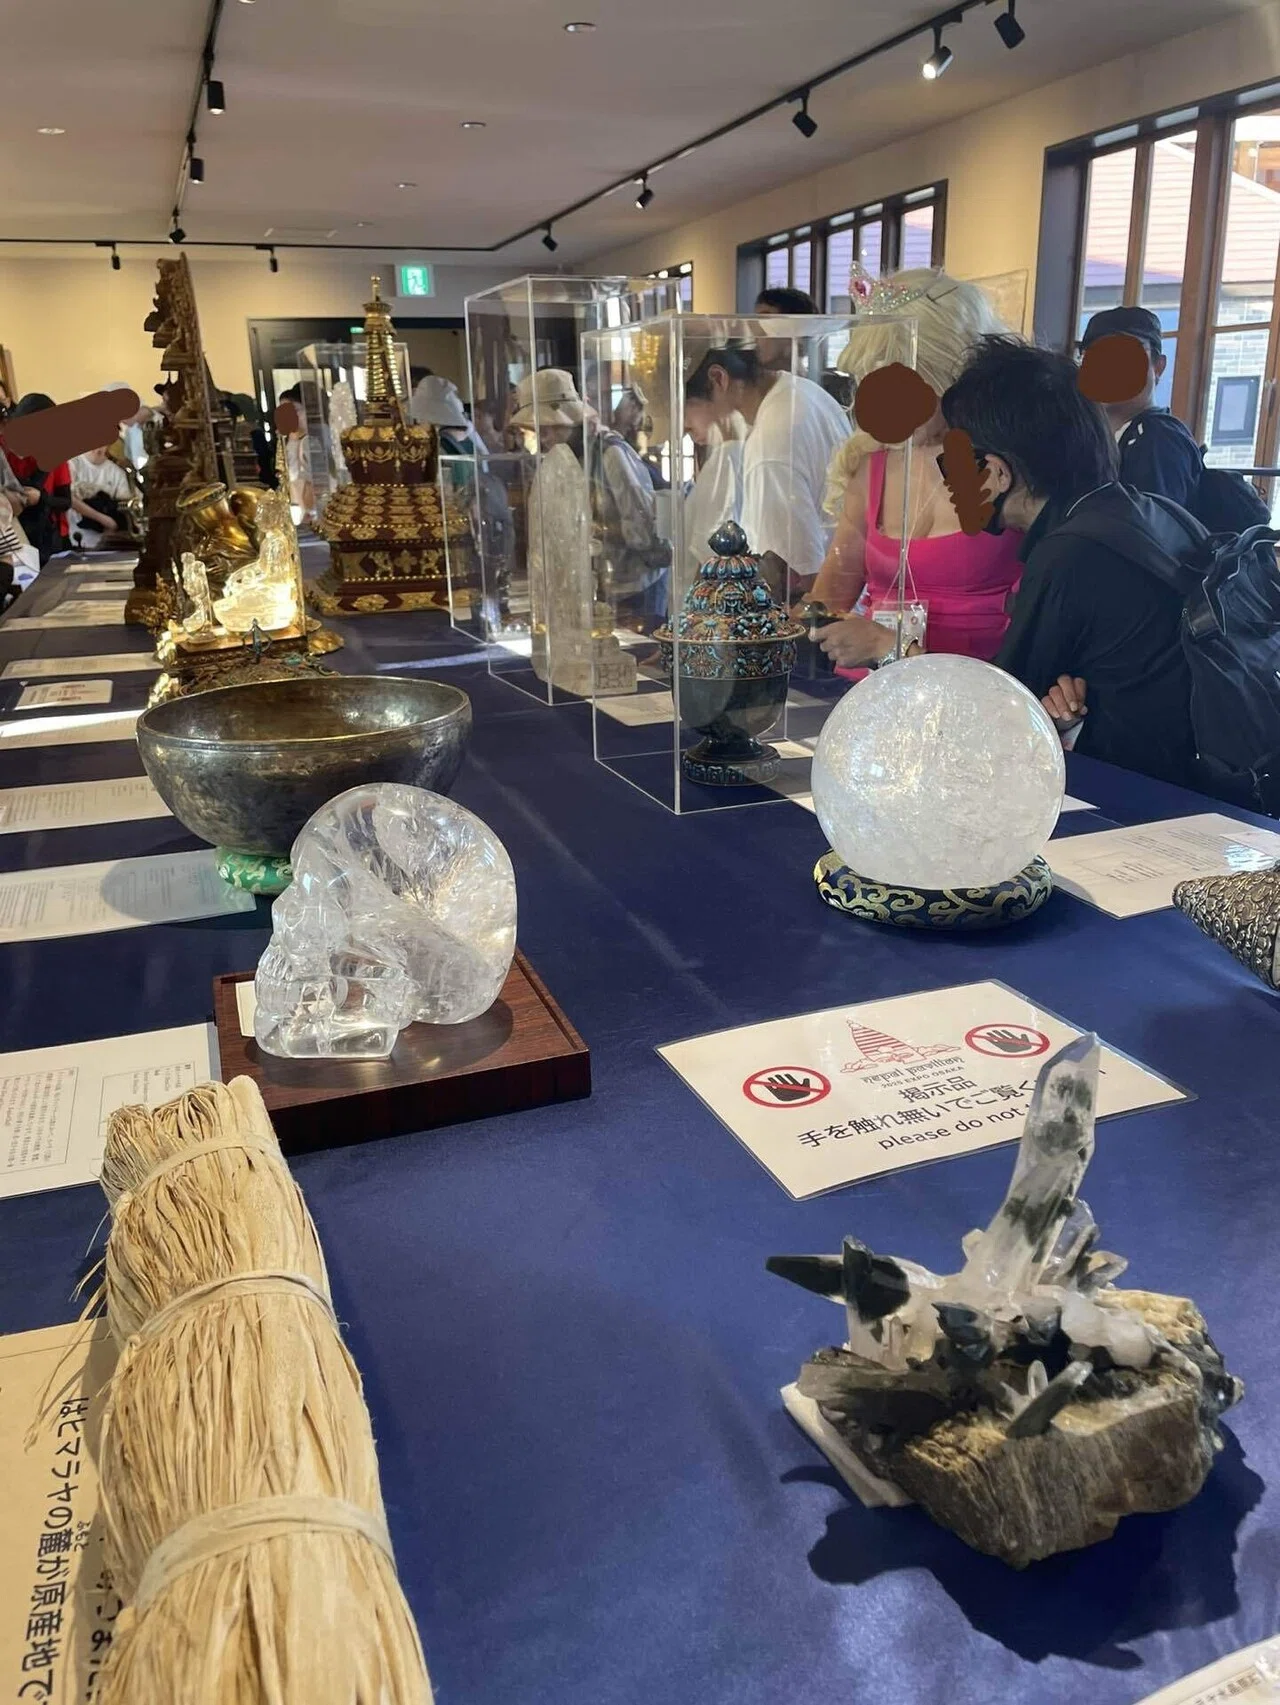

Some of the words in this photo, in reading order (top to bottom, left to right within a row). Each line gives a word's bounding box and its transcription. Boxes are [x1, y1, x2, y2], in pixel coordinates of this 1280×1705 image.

[898, 1075, 978, 1103] 掲示品
[905, 1073, 930, 1084] EXPO
[931, 1066, 965, 1077] OSAKA
[797, 1069, 1107, 1148] 手を触れ無いでご覧く
[878, 1126, 951, 1151] please
[954, 1116, 984, 1132] do
[986, 1106, 1026, 1124] not
[17, 1397, 90, 1705] はヒマラヤの麓が原産地で
